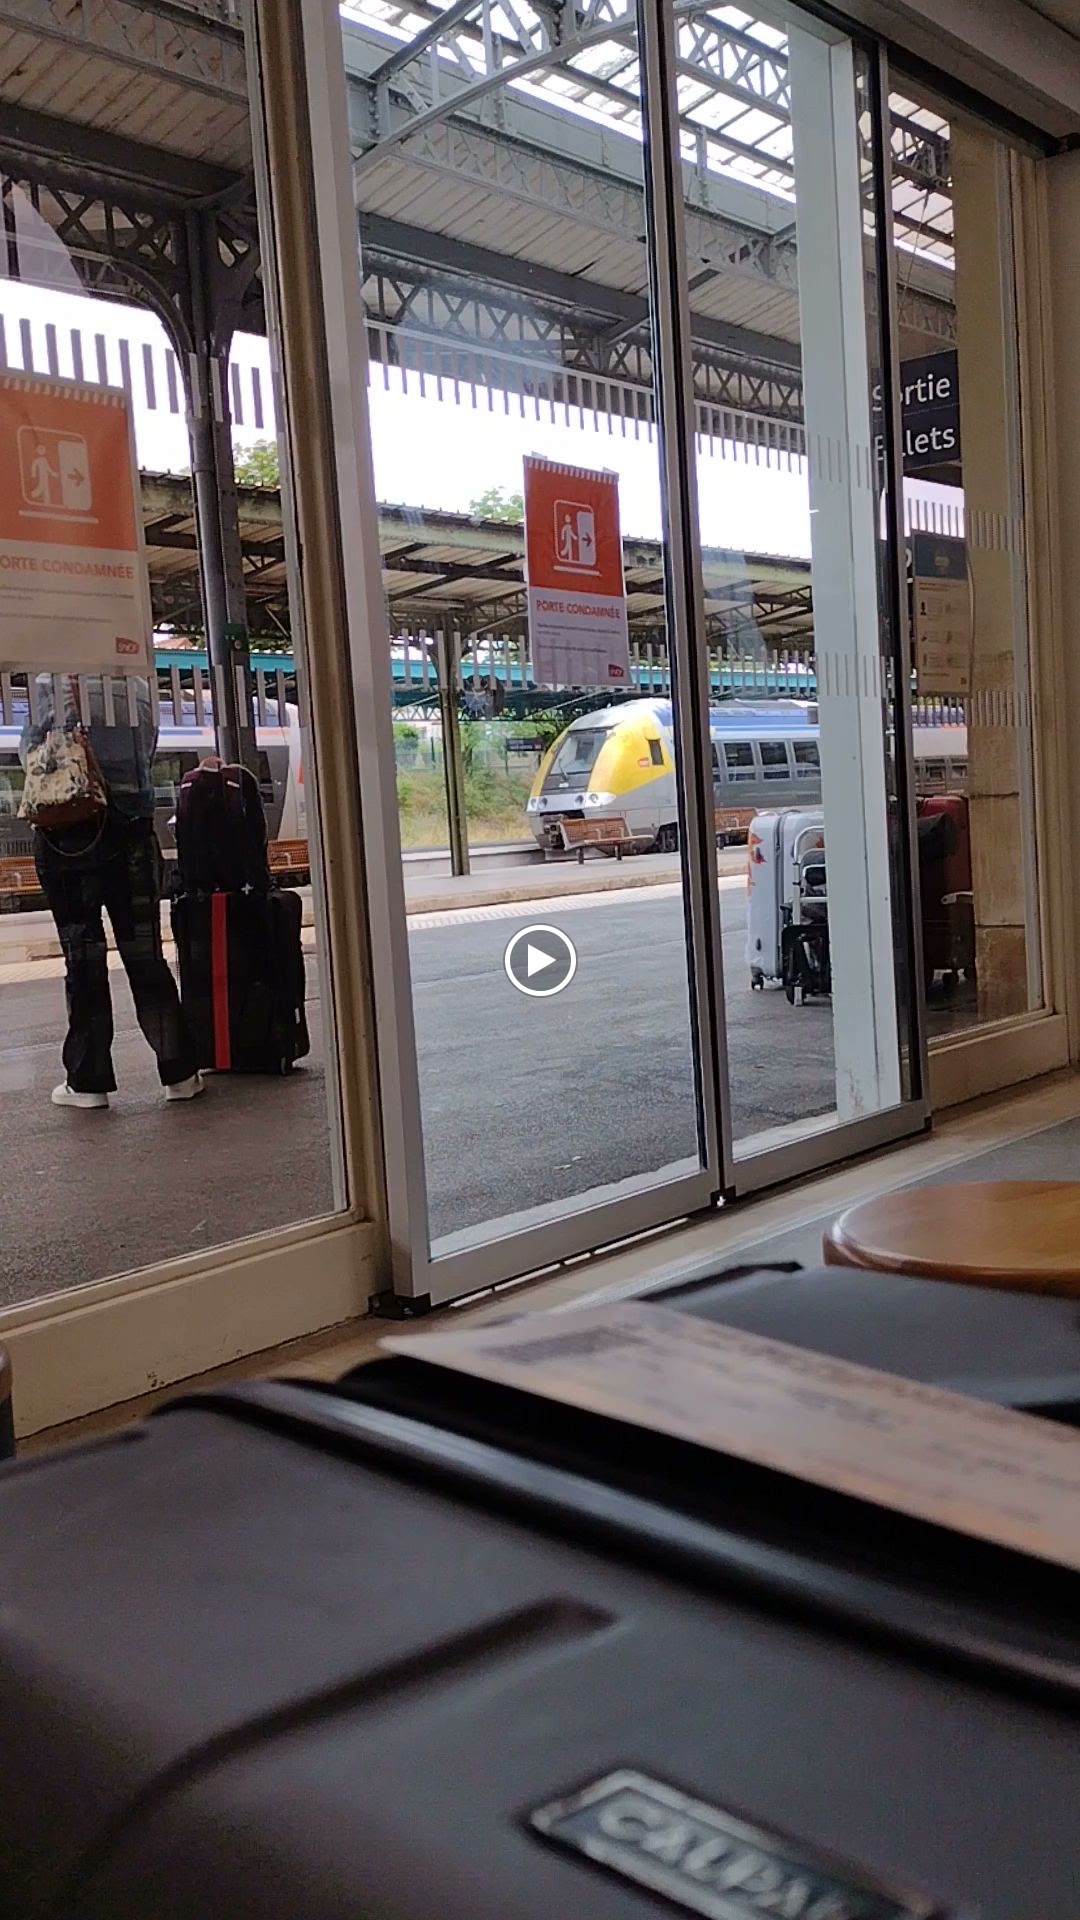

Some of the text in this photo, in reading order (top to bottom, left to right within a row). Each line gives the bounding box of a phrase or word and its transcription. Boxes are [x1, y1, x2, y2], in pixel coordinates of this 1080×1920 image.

[872, 373, 951, 411] Srtie
[874, 427, 956, 461] Blets
[0, 555, 37, 571] ORTE
[536, 599, 564, 613] PORTE
